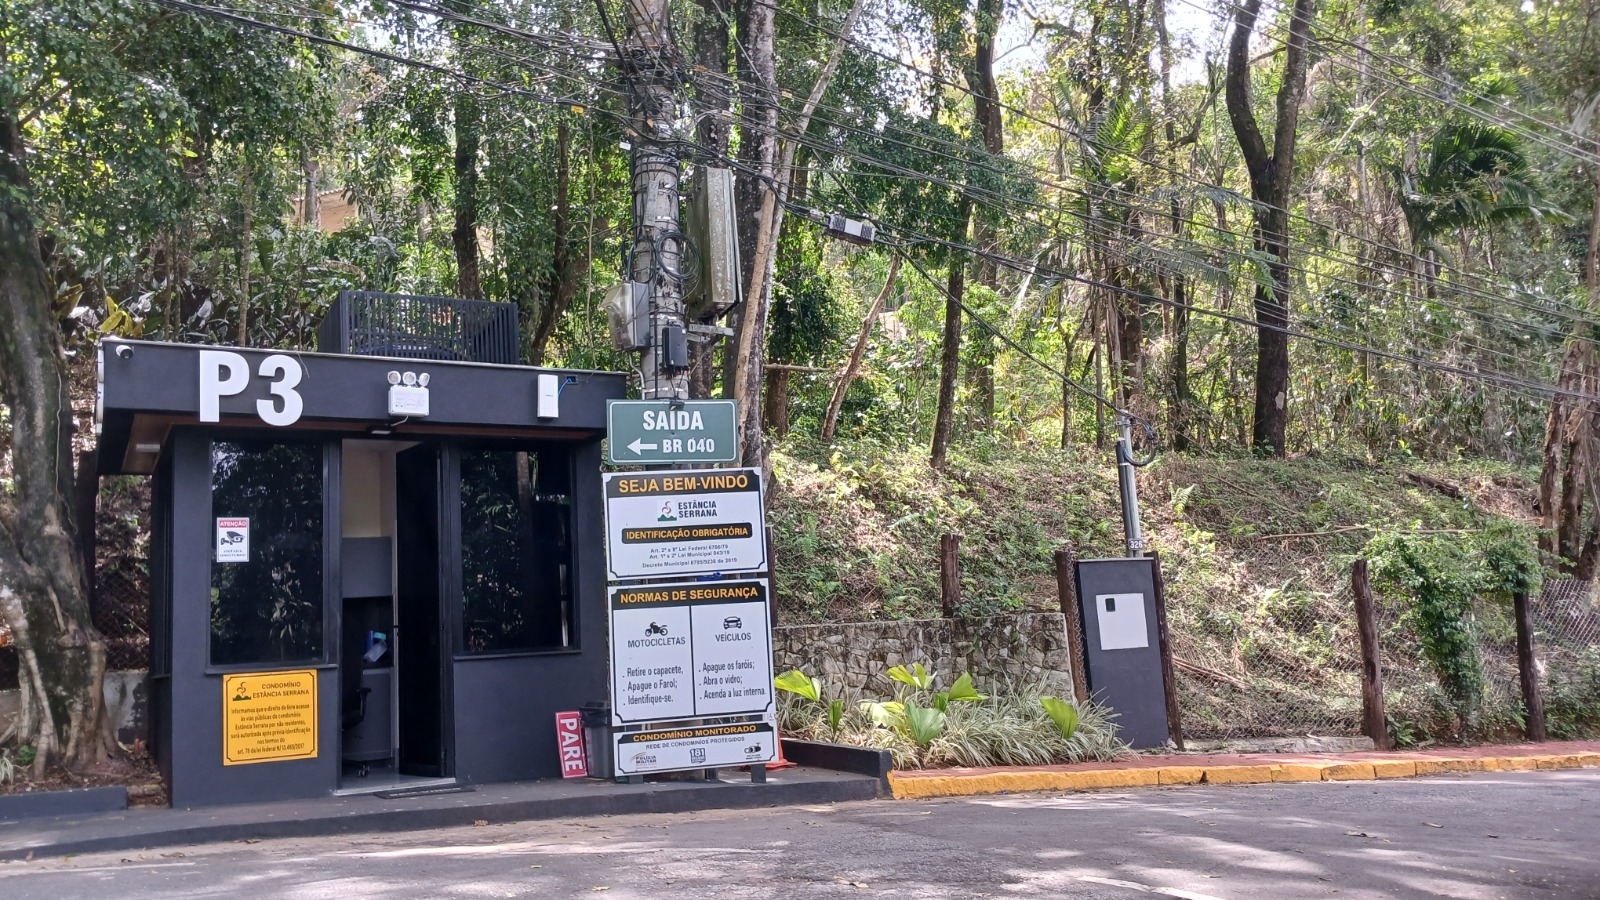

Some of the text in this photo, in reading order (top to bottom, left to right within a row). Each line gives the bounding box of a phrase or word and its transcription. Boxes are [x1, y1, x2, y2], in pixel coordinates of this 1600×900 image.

[643, 406, 704, 431] SAÍDA
[663, 438, 715, 453] BR 040
[619, 474, 748, 493] SEJA BEM-VINDO
[678, 500, 717, 510] ESTÂNCIA
[678, 509, 718, 518] SERRANA
[626, 526, 748, 540] IDENTIFICAÇÃO OBRIGATÓRIA
[620, 587, 758, 603] NORMAS DE SEGURANÇA
[628, 637, 686, 648] MOTOCICLETAS
[715, 632, 751, 642] VEÍCULOS
[627, 667, 646, 677] Retire
[654, 665, 684, 677] capacete,
[703, 662, 725, 673] Apague
[735, 659, 755, 670] faróis;
[262, 681, 300, 689] CONDOMÍNIO
[628, 682, 651, 692] Apague
[660, 679, 678, 689] Farol;
[703, 676, 718, 685] Abra
[725, 674, 742, 684] vidro;
[704, 690, 726, 700] Acenda
[733, 688, 742, 697] luz
[743, 687, 766, 696] interna.
[628, 694, 673, 706] Identifique-se.
[255, 714, 271, 722] públicas
[633, 725, 756, 742] CONDOMÍNIO MONITORADO
[560, 718, 583, 771] PARE
[690, 748, 705, 757] 181
